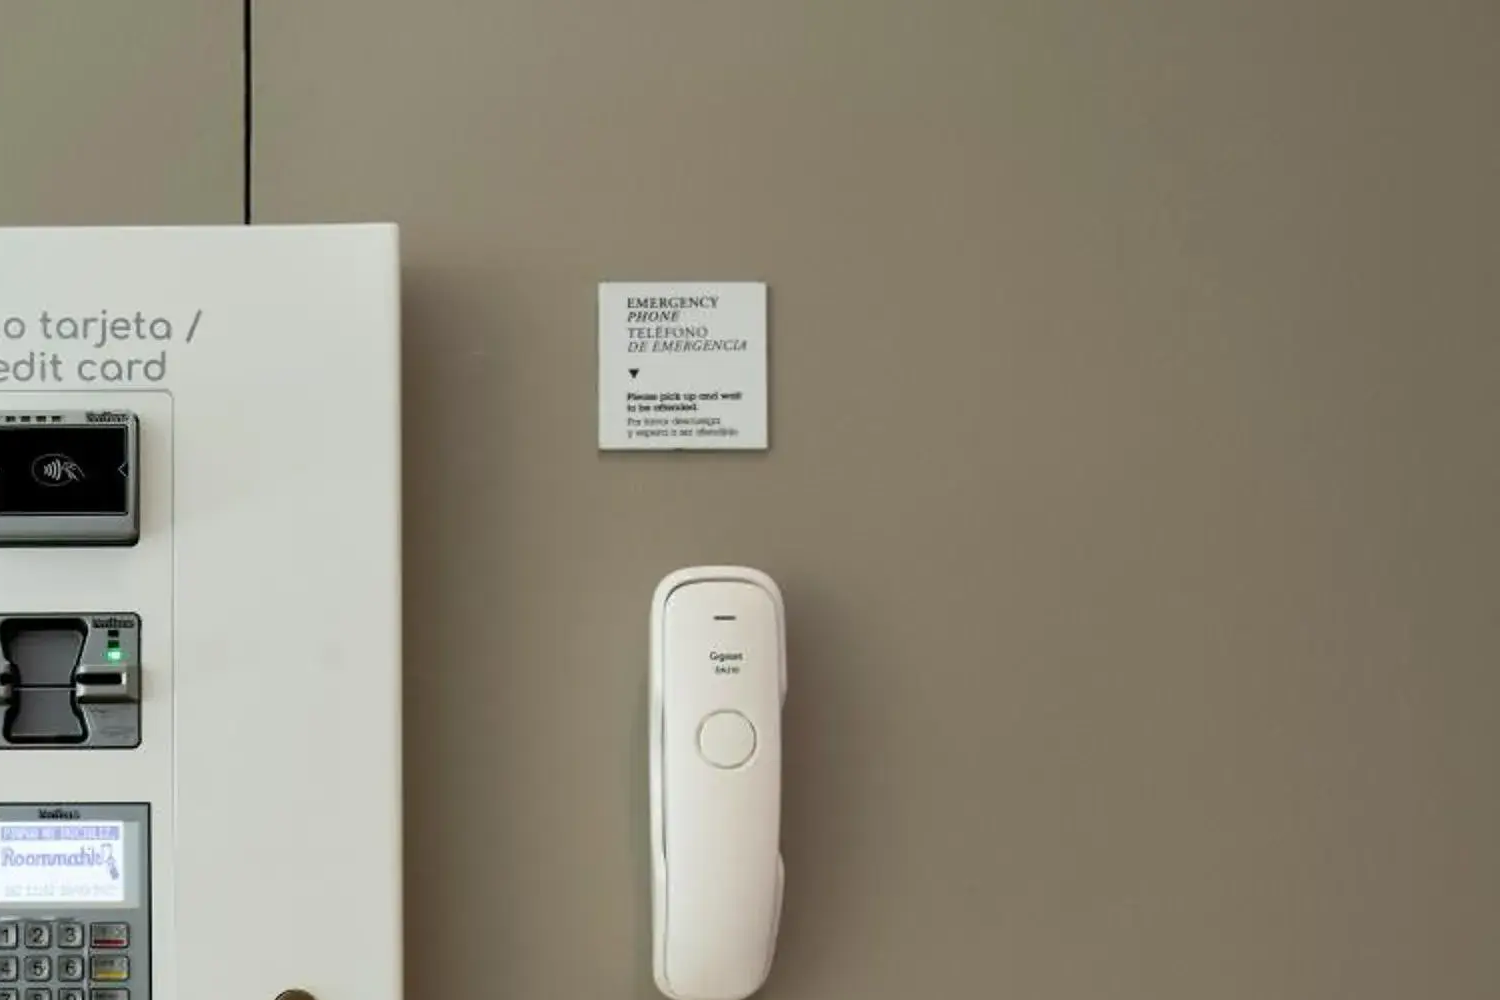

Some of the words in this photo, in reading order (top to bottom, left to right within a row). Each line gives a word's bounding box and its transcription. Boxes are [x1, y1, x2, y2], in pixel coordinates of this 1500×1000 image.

[627, 296, 719, 309] EMERGENCY
[627, 310, 680, 323] PHONE
[39, 309, 173, 349] tarjeta
[185, 309, 203, 344] /
[627, 341, 648, 353] DE
[651, 339, 748, 353] EMERGENCIA
[77, 350, 167, 383] card
[32, 927, 44, 944] 2
[64, 927, 77, 943] 3
[33, 961, 44, 976] 5
[65, 960, 77, 976] 6
